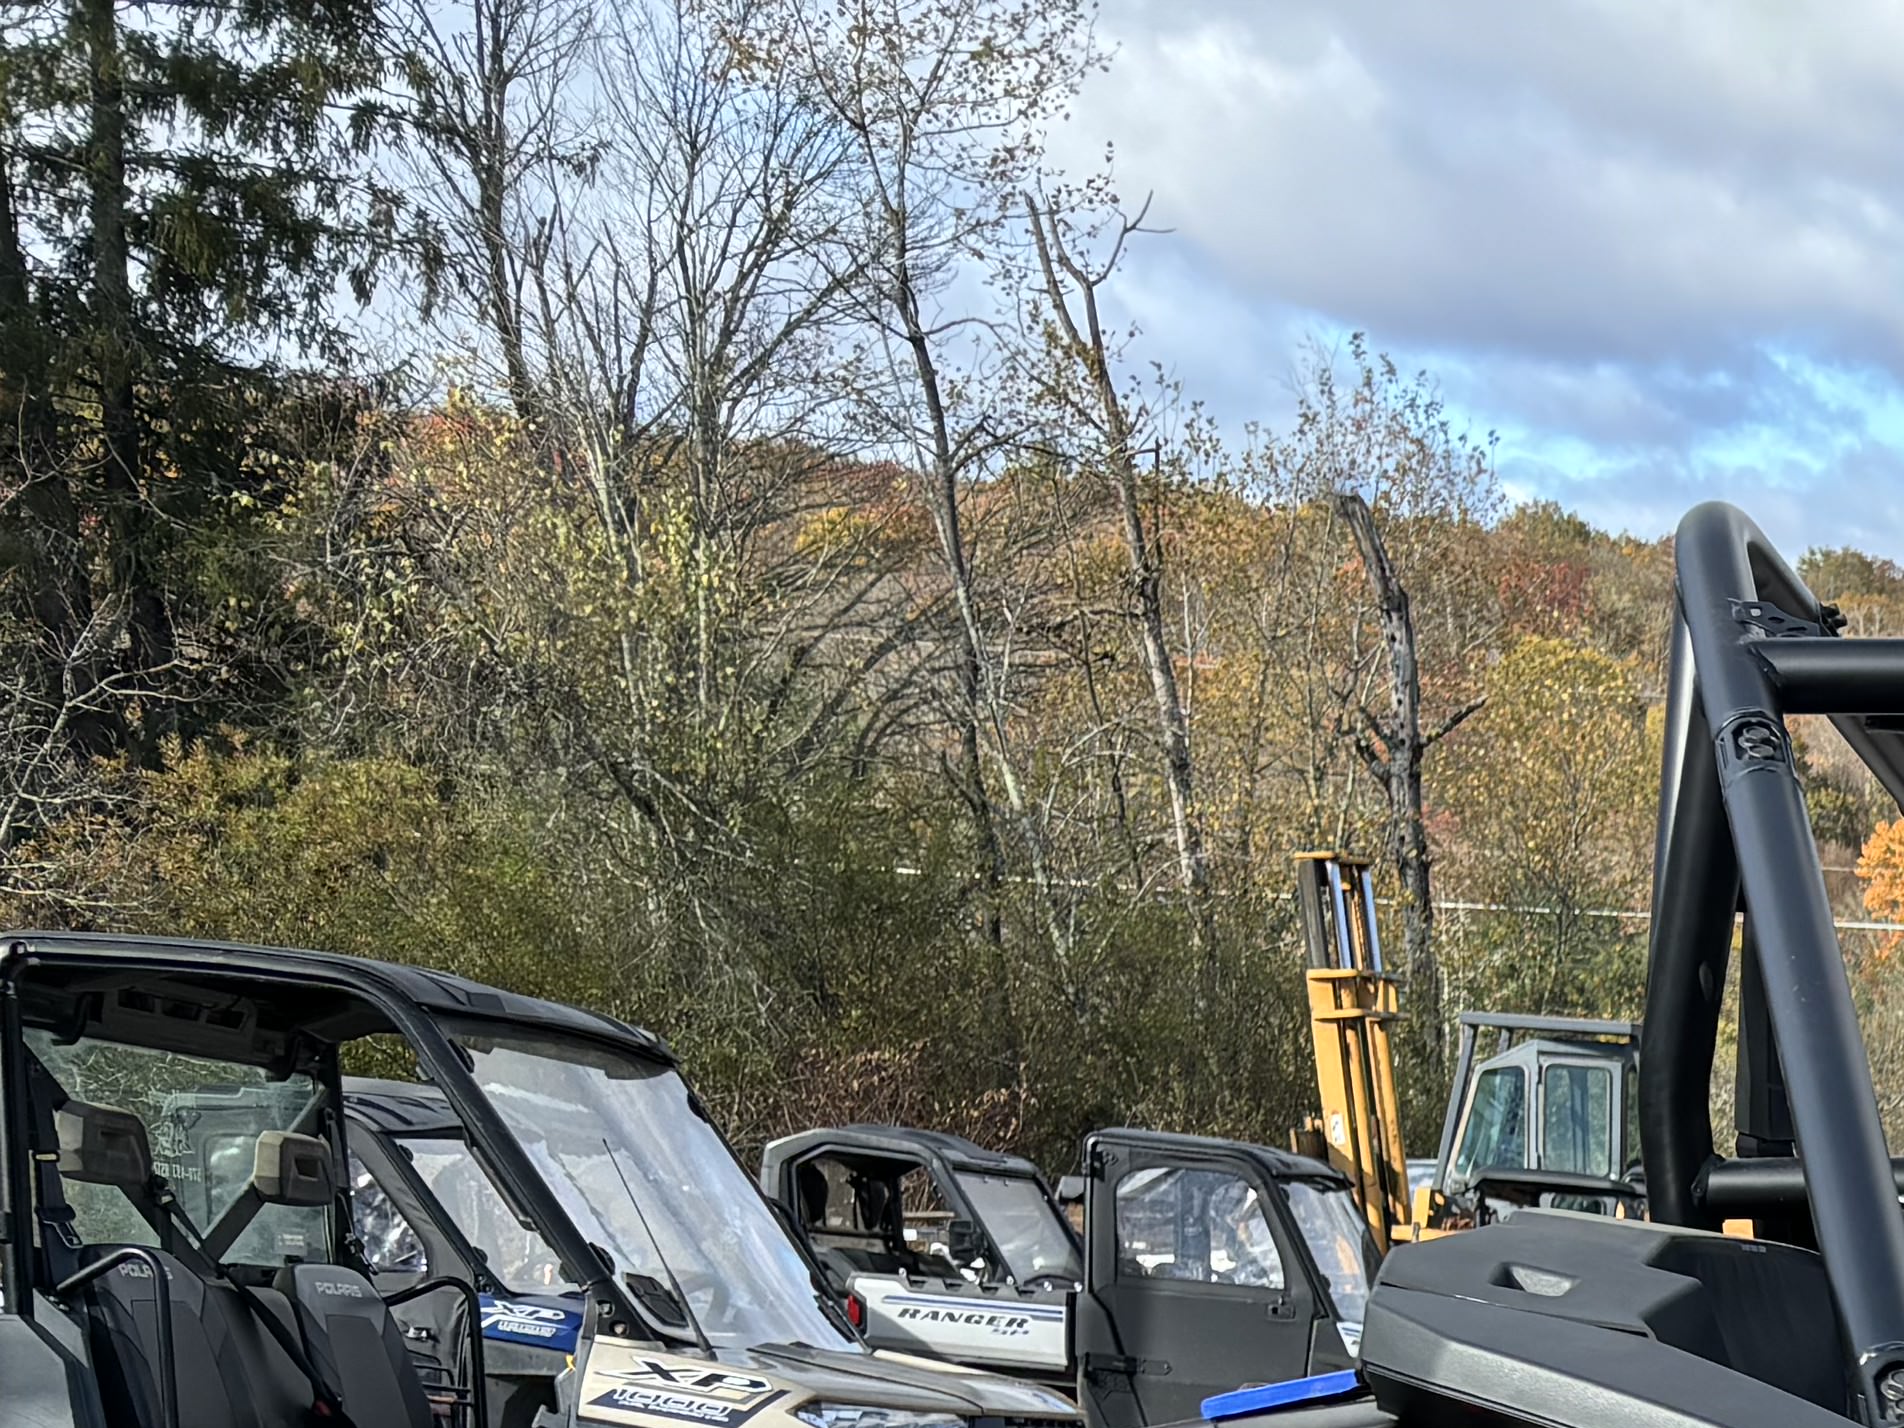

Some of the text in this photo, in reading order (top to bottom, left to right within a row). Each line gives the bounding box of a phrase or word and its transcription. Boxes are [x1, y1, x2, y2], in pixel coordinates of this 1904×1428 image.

[314, 1281, 363, 1298] POLARIS
[481, 1300, 565, 1321] XP
[898, 1308, 1029, 1329] RANGER
[594, 1355, 773, 1394] XP
[612, 1388, 734, 1417] 1000
